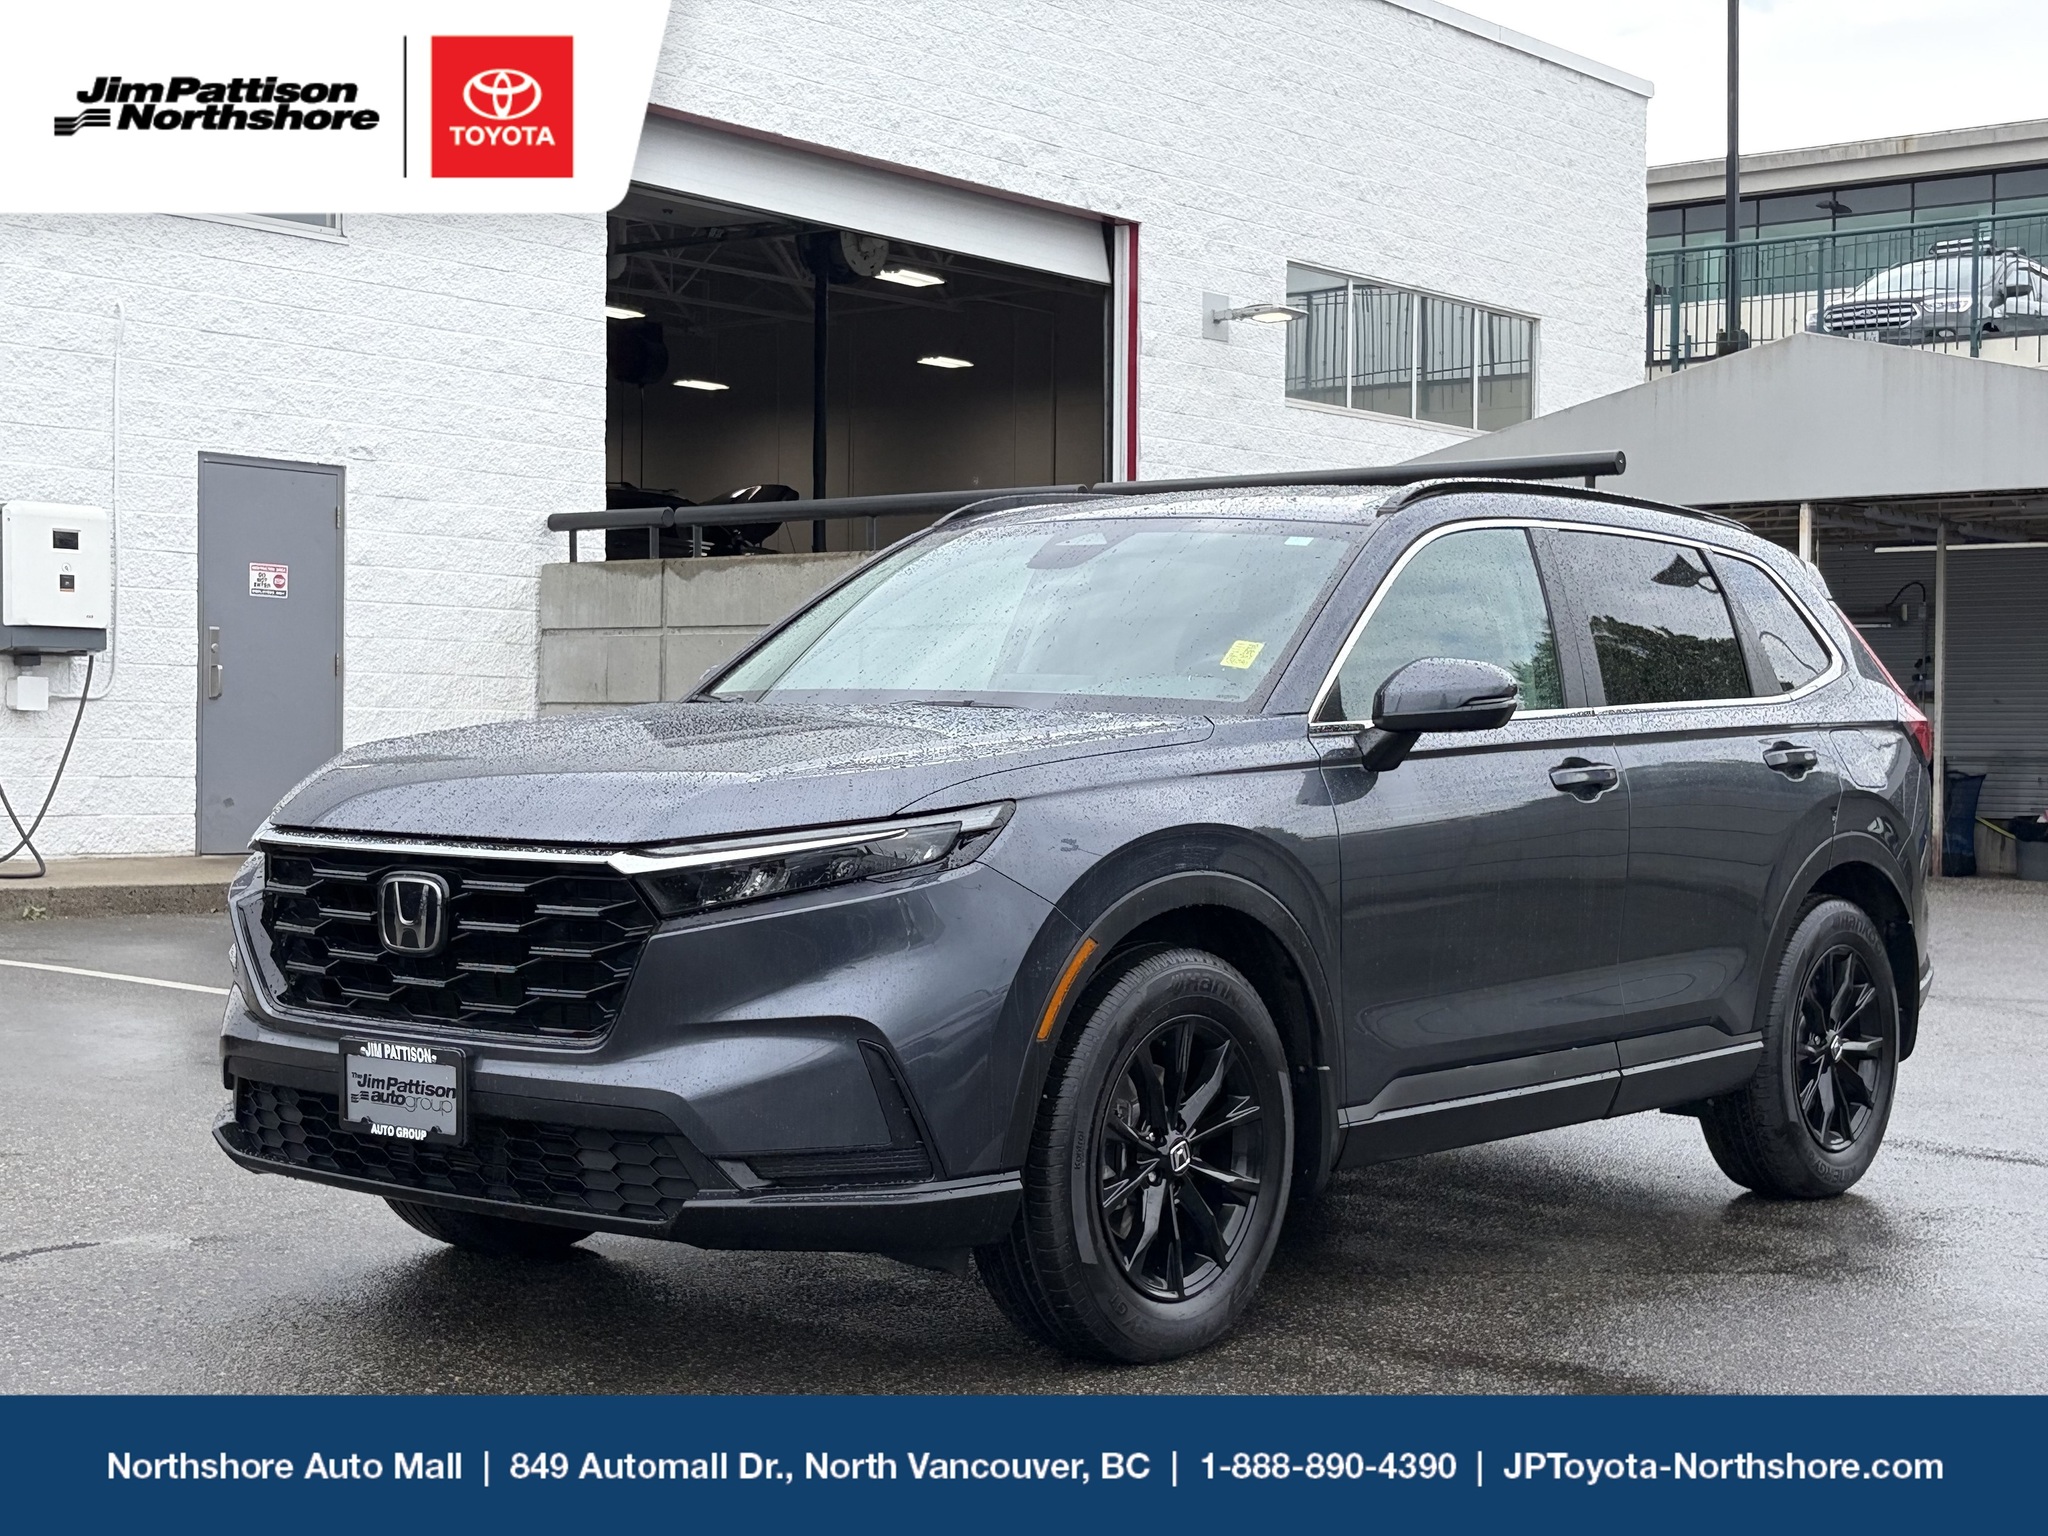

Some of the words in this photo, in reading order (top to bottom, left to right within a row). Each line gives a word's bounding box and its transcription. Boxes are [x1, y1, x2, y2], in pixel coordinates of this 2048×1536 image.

[365, 1042, 383, 1059] JIM
[384, 1043, 432, 1064] PATTISON
[357, 1073, 386, 1091] Jim
[386, 1077, 457, 1100] Pattison
[370, 1123, 395, 1137] AUTO
[395, 1126, 428, 1141] GROUP
